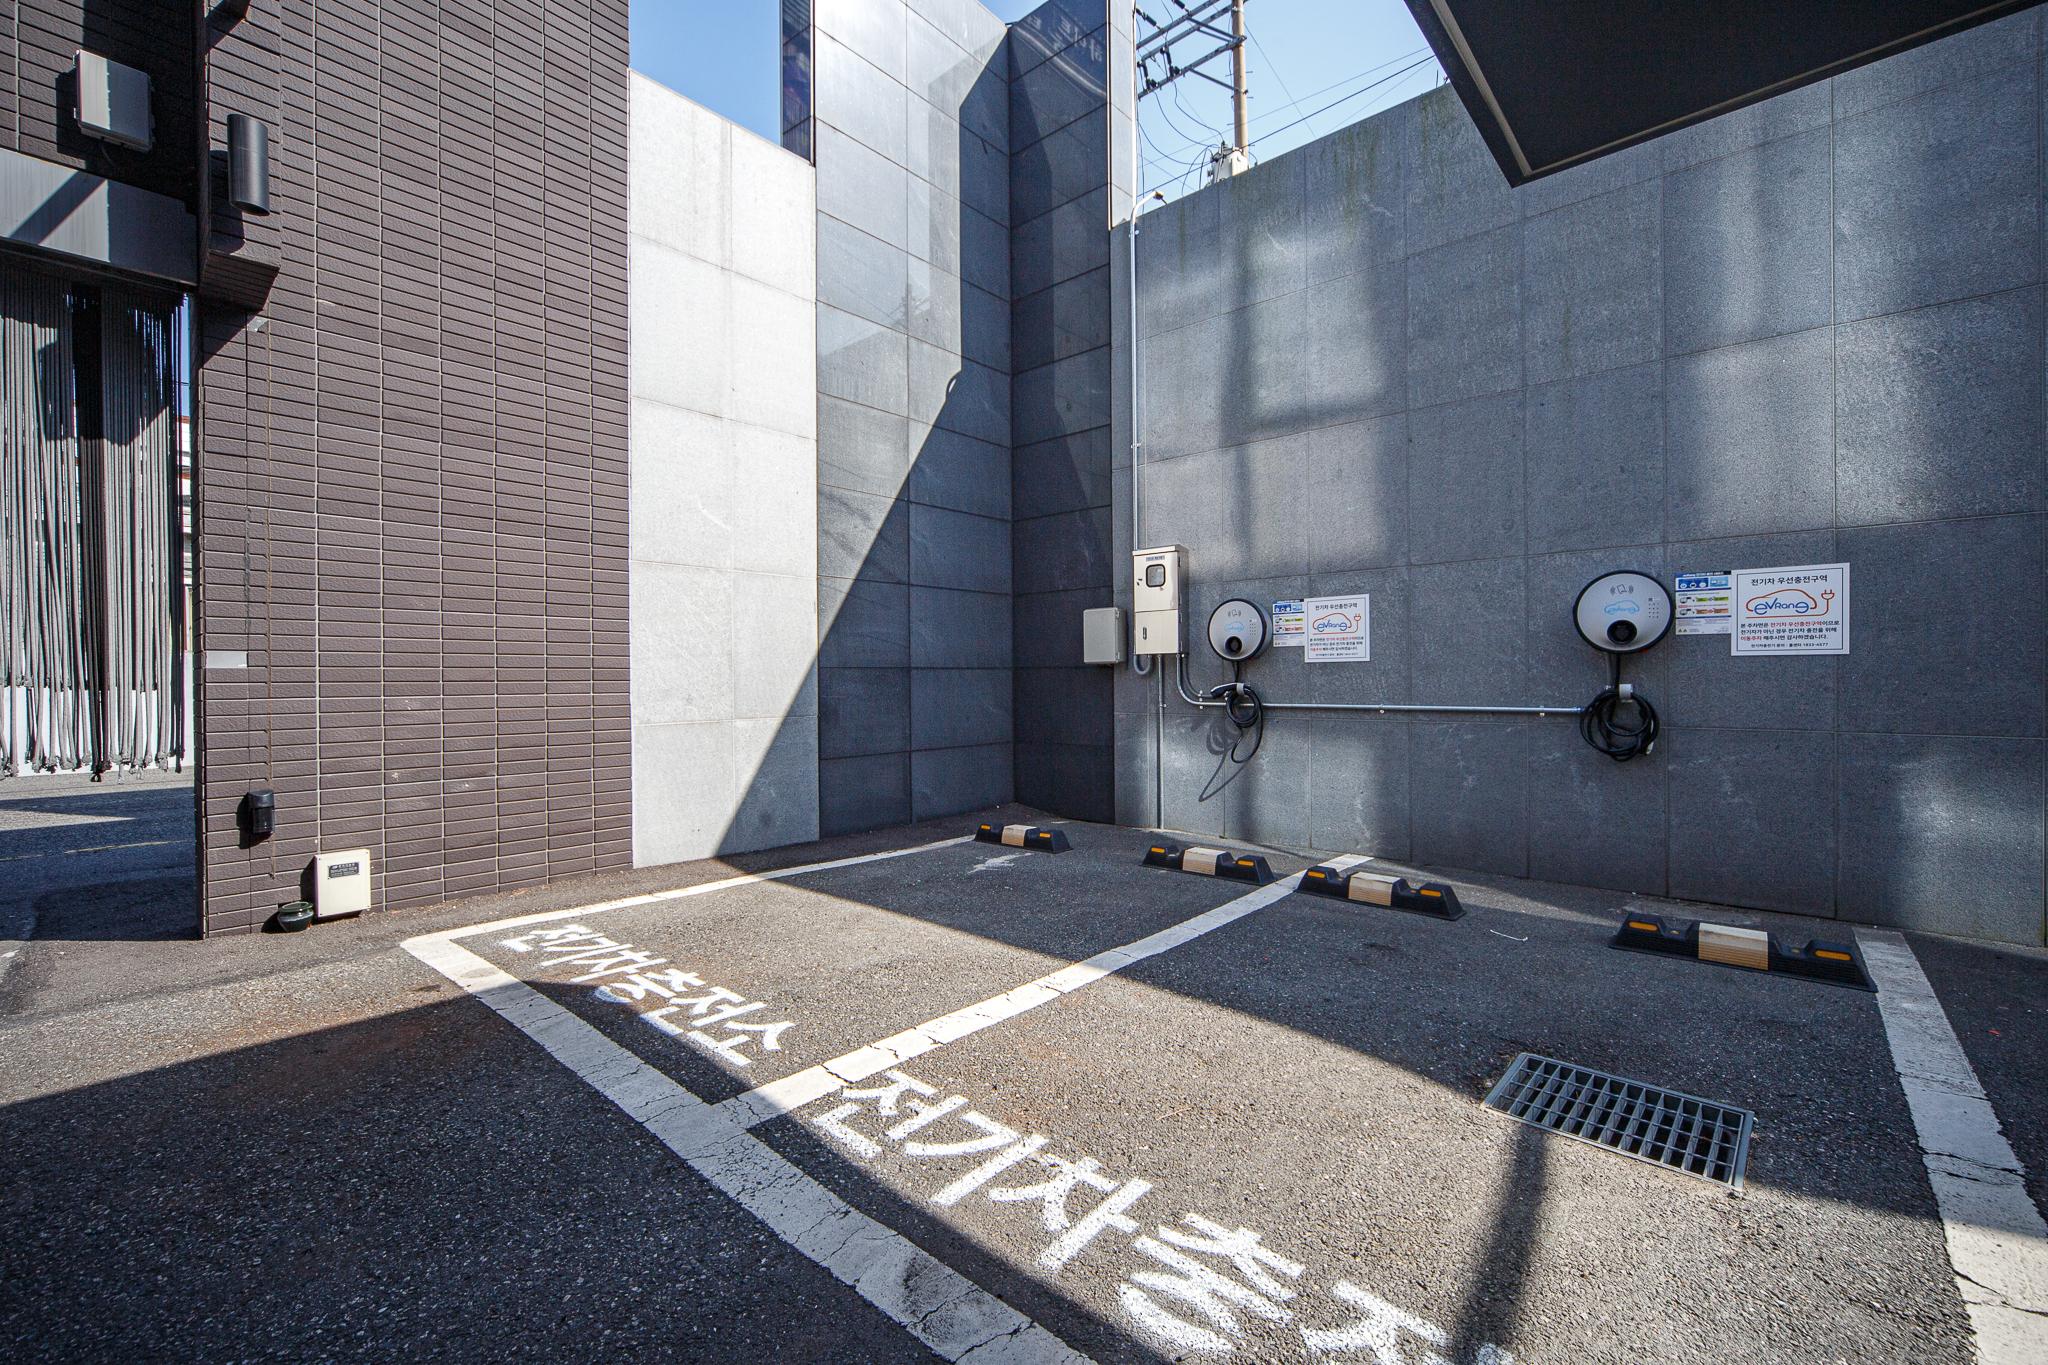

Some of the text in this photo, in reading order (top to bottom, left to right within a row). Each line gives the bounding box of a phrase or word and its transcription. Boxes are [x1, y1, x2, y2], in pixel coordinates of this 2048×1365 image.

[1751, 574, 1828, 586] 전기차 우선충전구역
[500, 924, 797, 1067] 전기차충전소
